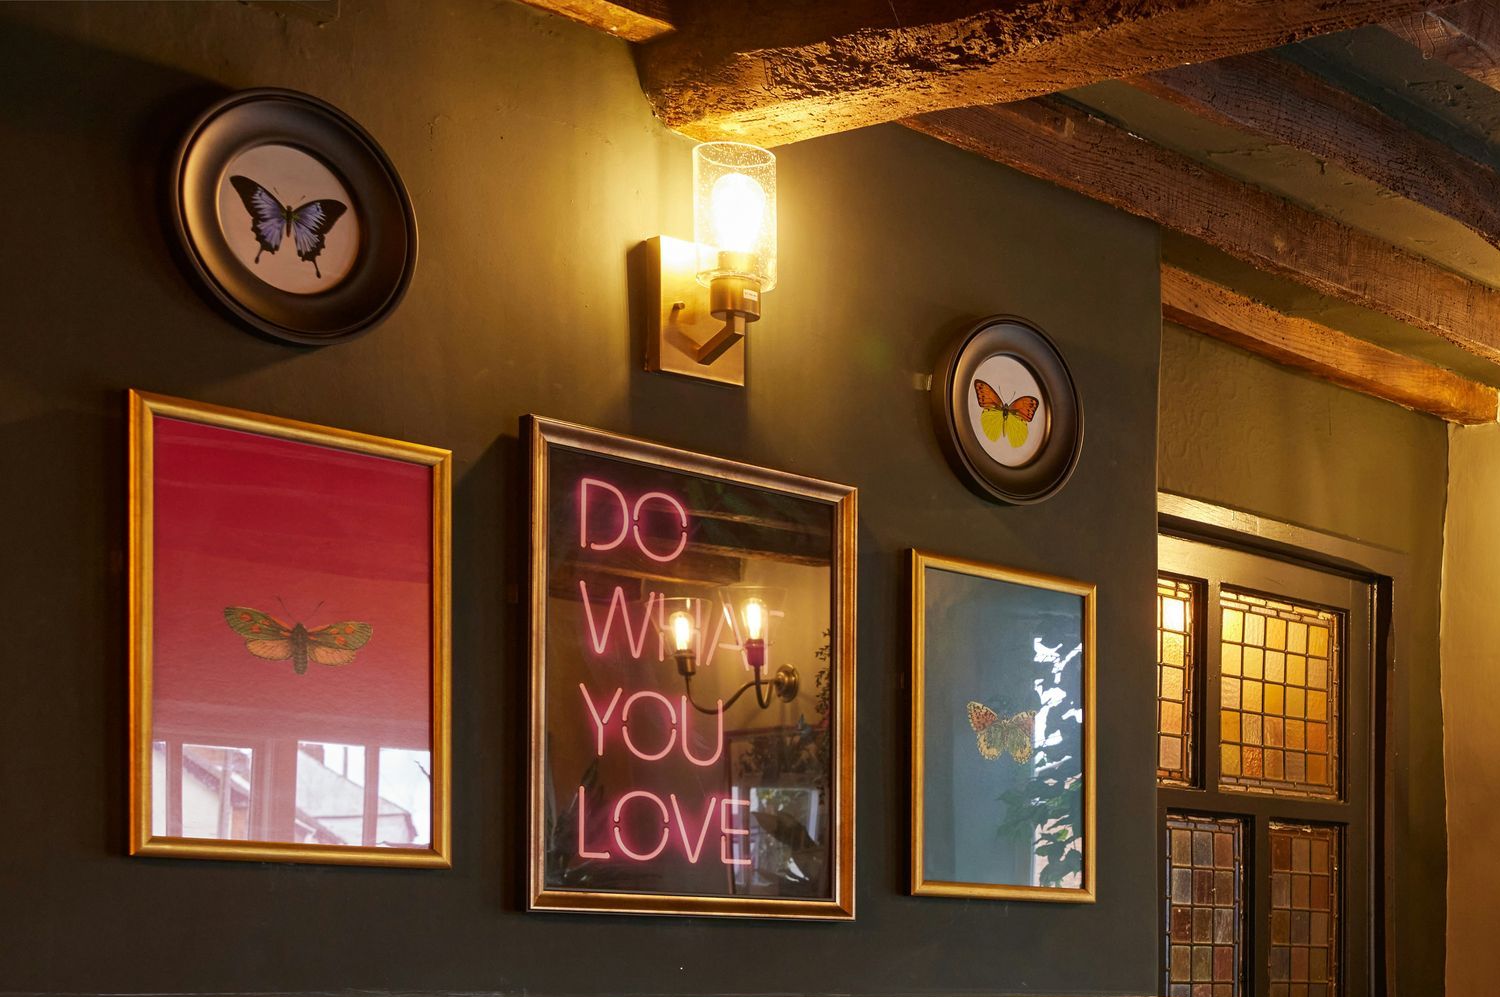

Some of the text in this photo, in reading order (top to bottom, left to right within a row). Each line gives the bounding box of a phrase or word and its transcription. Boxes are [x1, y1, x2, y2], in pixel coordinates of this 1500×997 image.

[580, 478, 687, 562] DO
[580, 580, 784, 675] WHAT
[580, 683, 723, 766] YOU
[579, 785, 752, 864] LOVE
